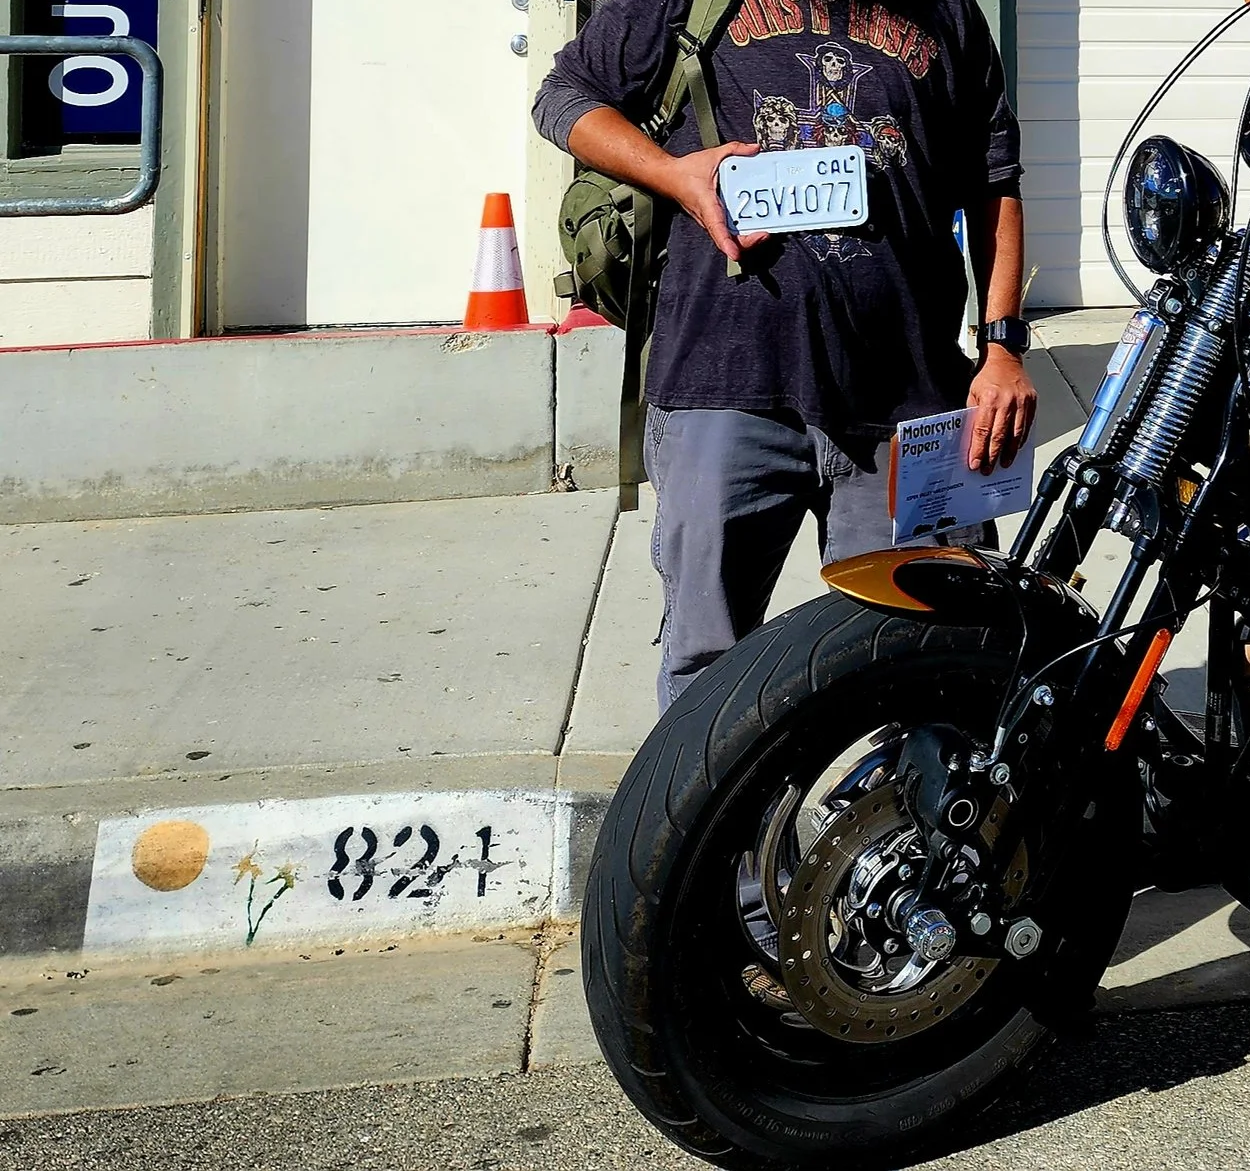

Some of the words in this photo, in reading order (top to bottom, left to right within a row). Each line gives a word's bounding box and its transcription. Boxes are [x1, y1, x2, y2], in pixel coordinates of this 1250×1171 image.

[816, 159, 854, 175] CAL
[737, 181, 851, 219] 25V1077
[902, 416, 962, 441] Motorcycle
[901, 439, 940, 458] Papers
[327, 824, 495, 901] 821
